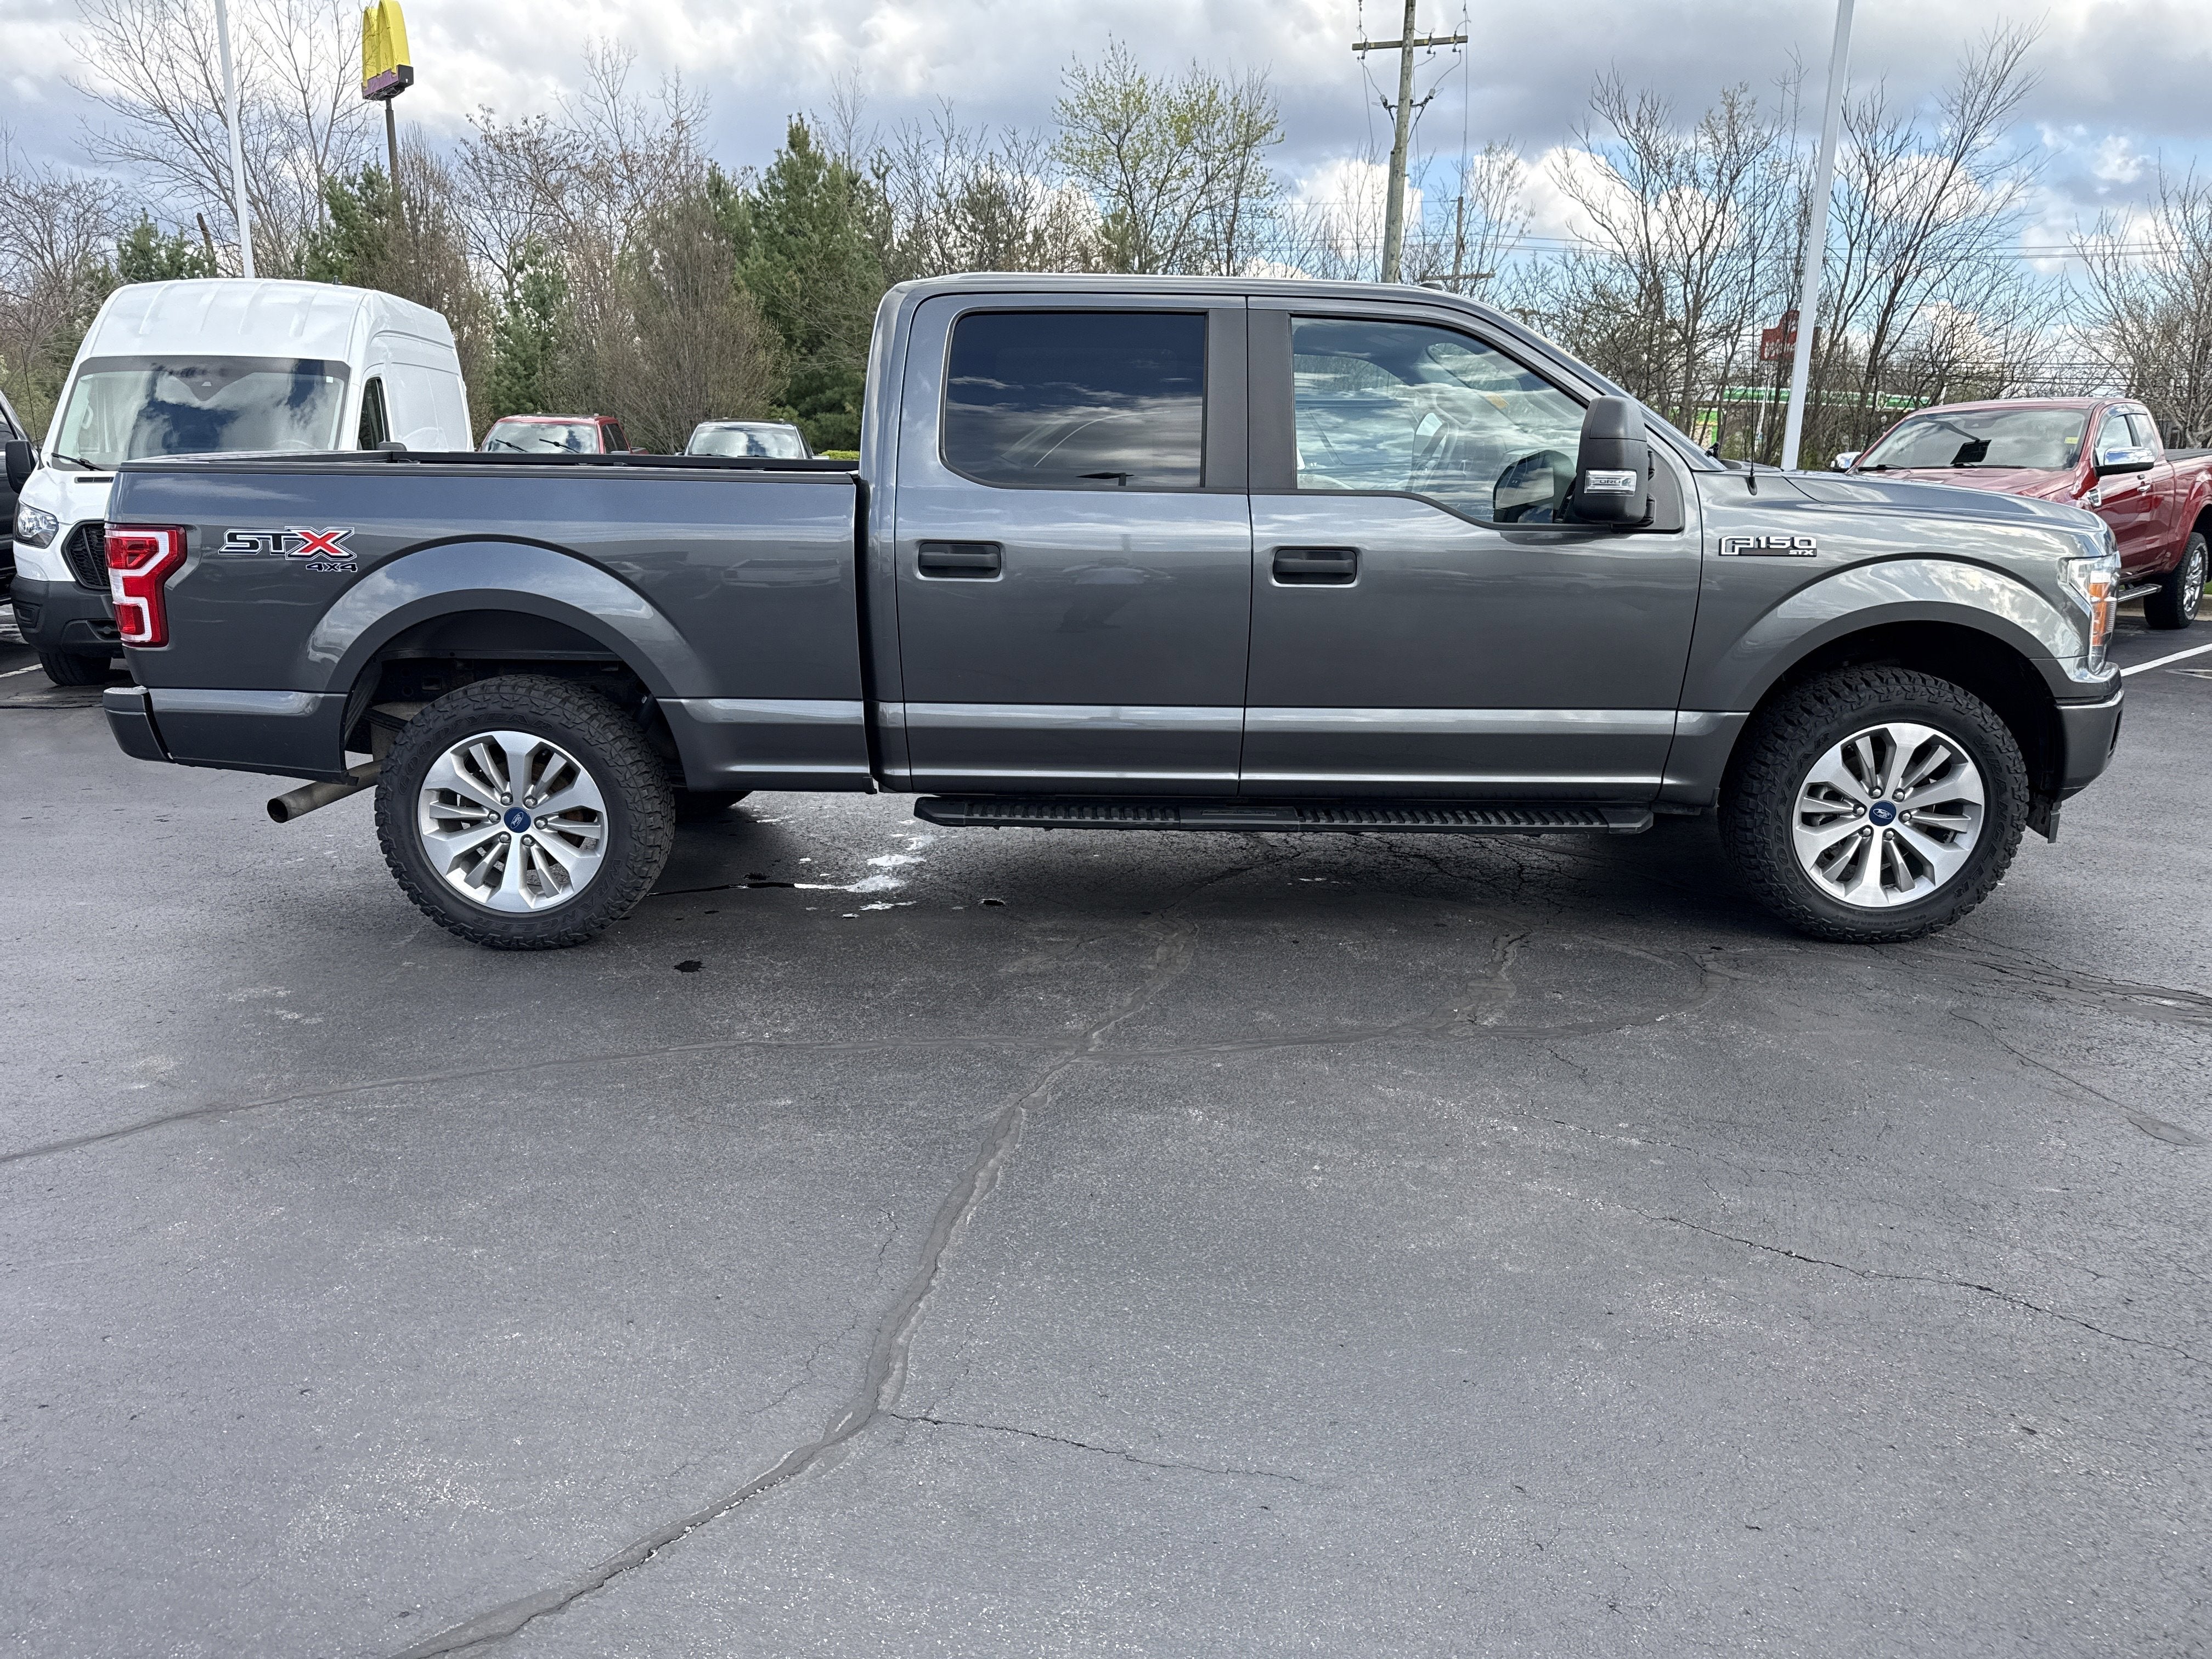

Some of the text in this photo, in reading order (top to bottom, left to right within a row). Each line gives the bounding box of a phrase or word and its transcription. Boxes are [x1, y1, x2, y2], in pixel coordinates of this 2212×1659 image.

[218, 526, 357, 561] STX
[398, 712, 555, 795] GOODYEAR
[1774, 732, 1832, 900] GOODYEAR
[1952, 734, 2012, 900] WRANGLER
[472, 857, 624, 934] WRANGLER
